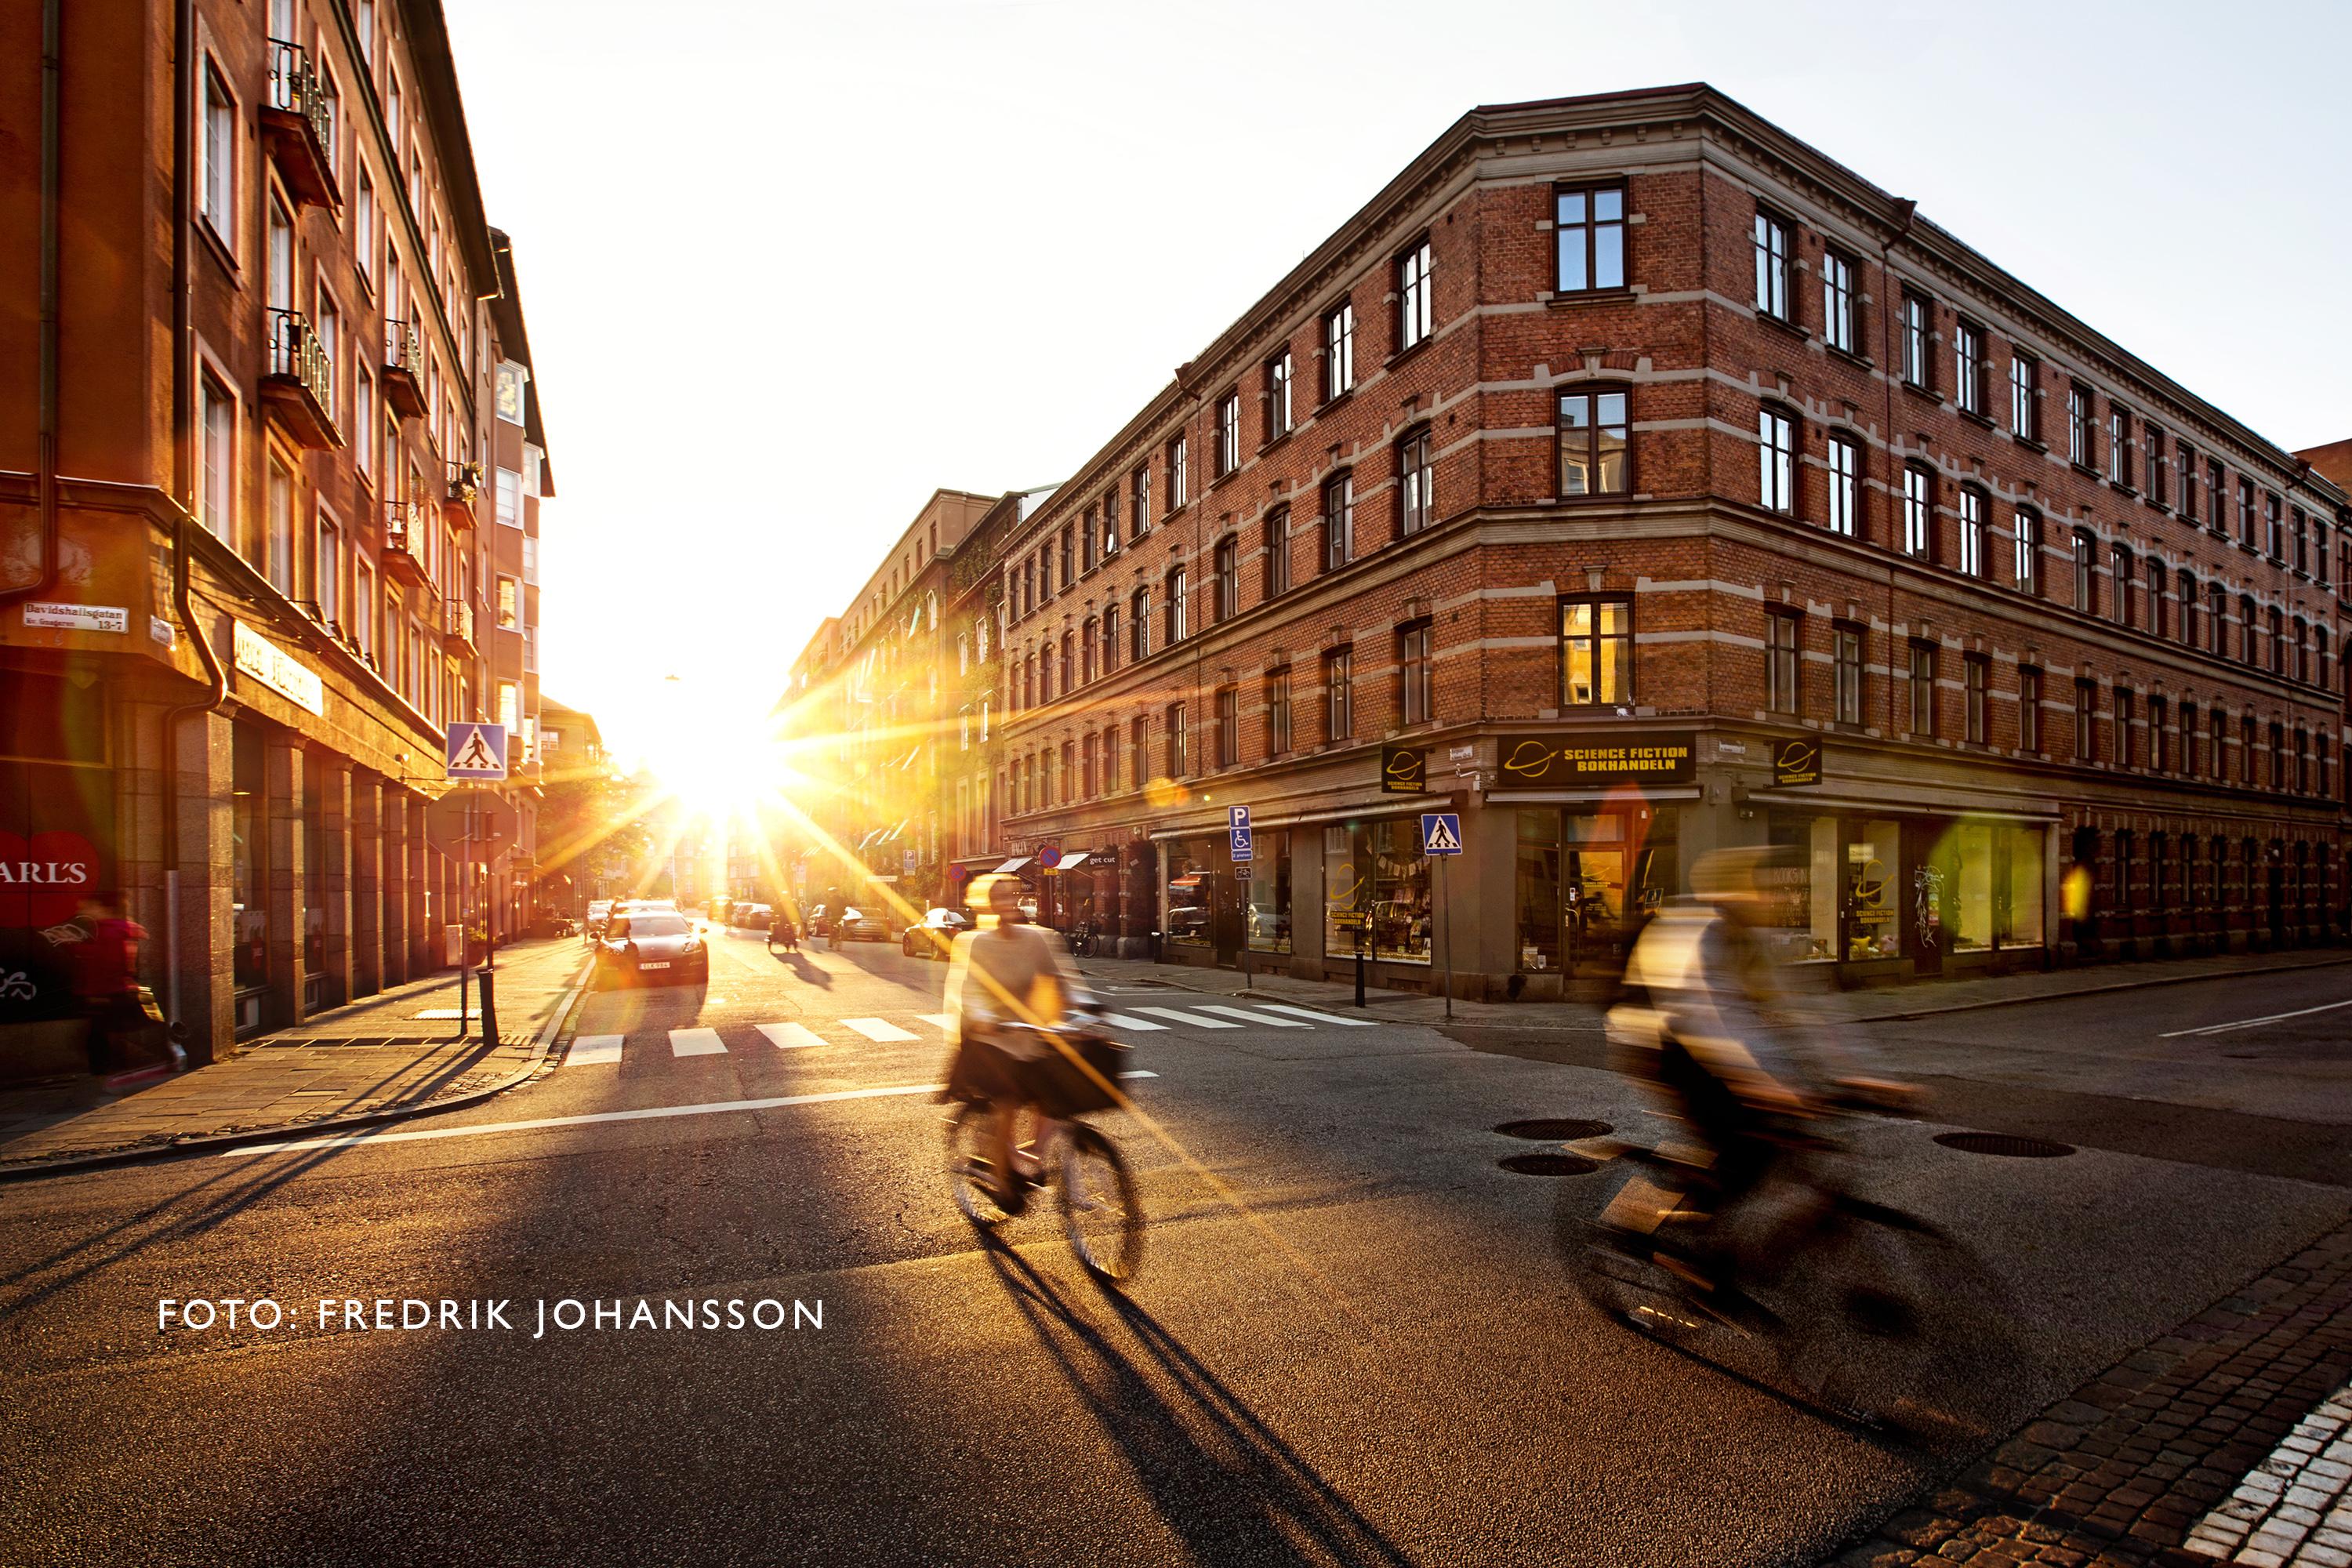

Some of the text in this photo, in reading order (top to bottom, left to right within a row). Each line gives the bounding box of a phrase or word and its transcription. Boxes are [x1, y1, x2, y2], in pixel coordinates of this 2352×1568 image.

[26, 603, 122, 620] Davidshallsgatan
[98, 620, 122, 630] 13-7
[1564, 746, 1688, 760] SCIENCE FICTION
[1577, 759, 1675, 771] BOKHANDELN
[1234, 808, 1247, 826] P
